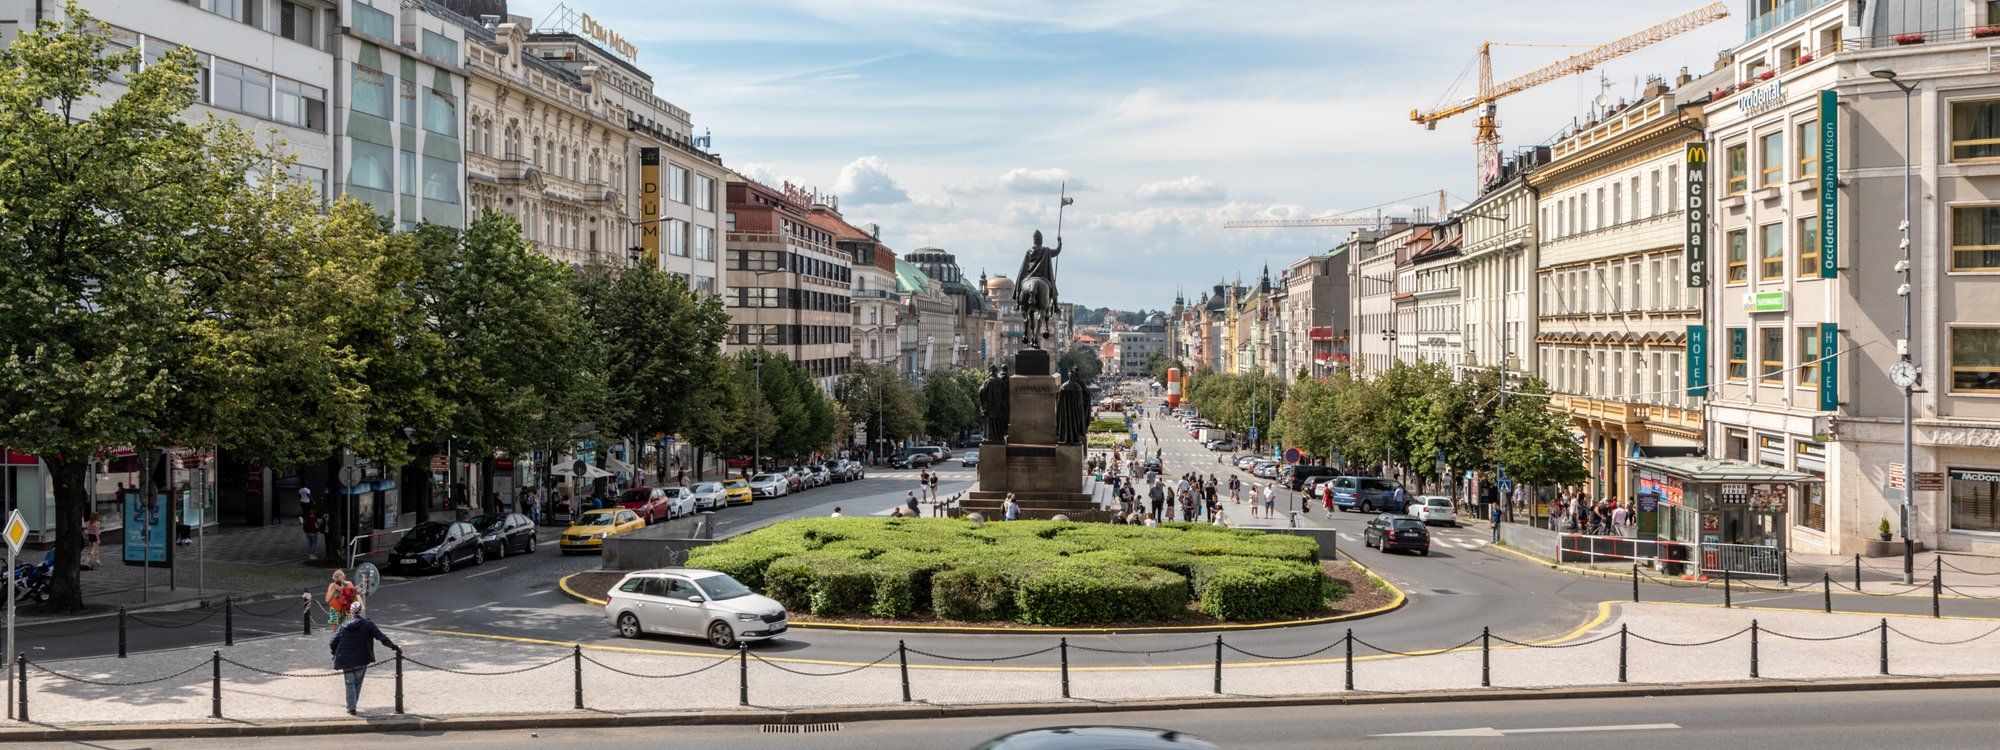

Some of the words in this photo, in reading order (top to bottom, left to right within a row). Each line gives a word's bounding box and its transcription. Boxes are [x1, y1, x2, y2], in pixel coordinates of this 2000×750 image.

[1824, 122, 1834, 168] Wilson
[643, 182, 657, 237] DŮM
[1824, 170, 1834, 200] Praha
[1688, 169, 1704, 286] McDonald's
[1824, 203, 1835, 270] Occidental
[1693, 332, 1701, 390] HOTEL
[1825, 331, 1833, 404] HOTEL
